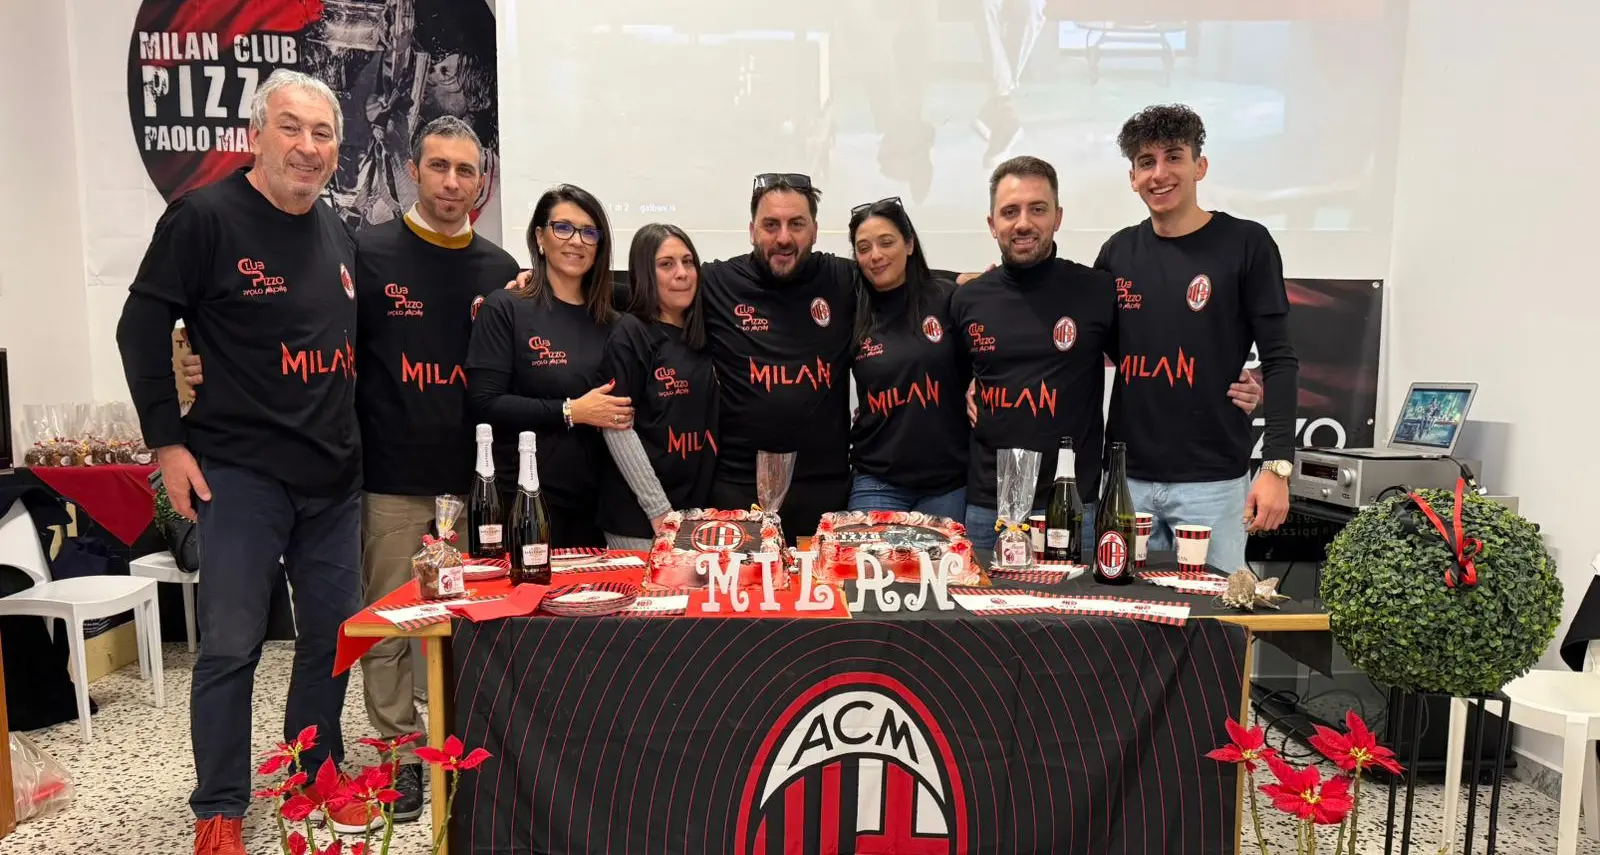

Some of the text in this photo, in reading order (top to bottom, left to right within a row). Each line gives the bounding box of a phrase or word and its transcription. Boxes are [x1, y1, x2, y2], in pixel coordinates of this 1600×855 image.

[139, 31, 297, 64] MILAN CLUB
[142, 65, 259, 119] PIZZ
[144, 125, 251, 152] PAOLO MA
[402, 352, 468, 392] MILA
[749, 356, 831, 393] MILAN
[1120, 347, 1195, 388] MILAN
[867, 372, 939, 418] MILAN
[980, 379, 1057, 418] MILAN
[668, 425, 719, 460] MILA
[696, 551, 963, 613] MILAN
[787, 701, 919, 771] ACM
